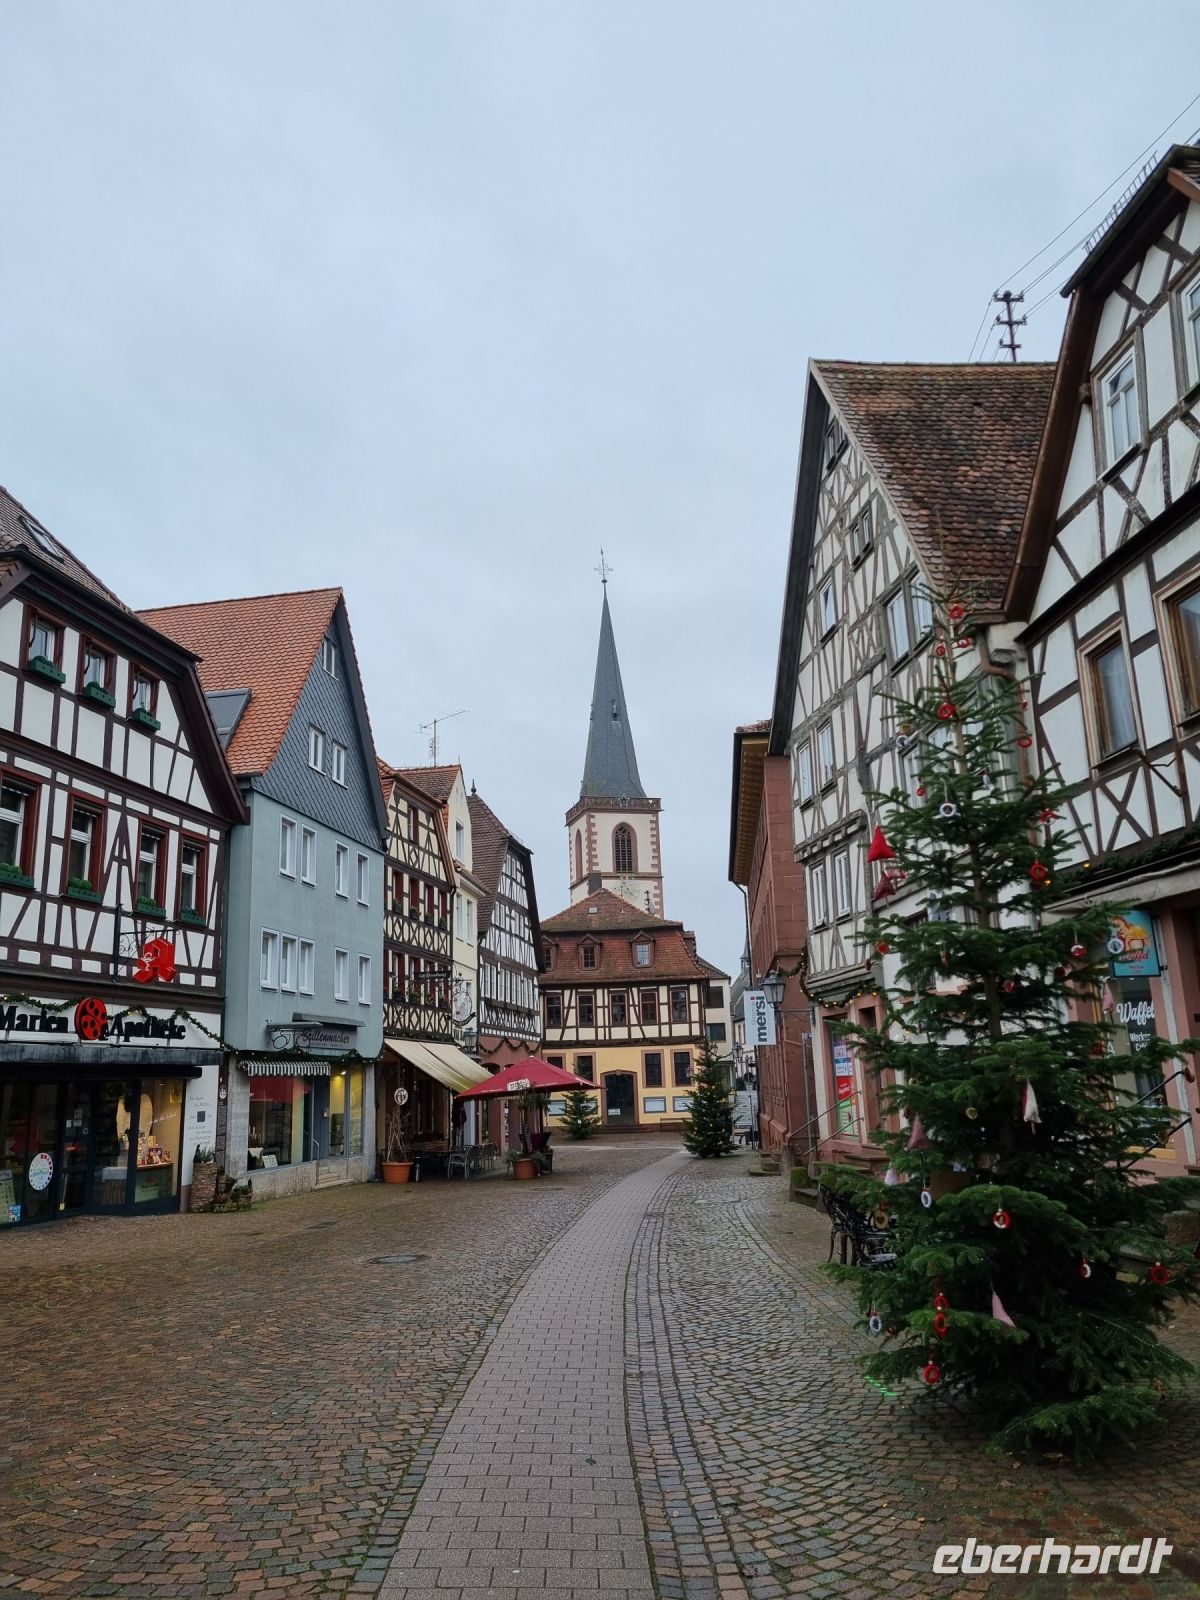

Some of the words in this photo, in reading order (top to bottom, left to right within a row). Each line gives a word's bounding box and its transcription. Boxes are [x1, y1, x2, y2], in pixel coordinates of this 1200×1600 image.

[0, 1004, 69, 1034] Marien
[108, 1012, 187, 1042] Apotheke
[750, 995, 767, 1043] mersi
[1116, 1001, 1156, 1026] Waffel
